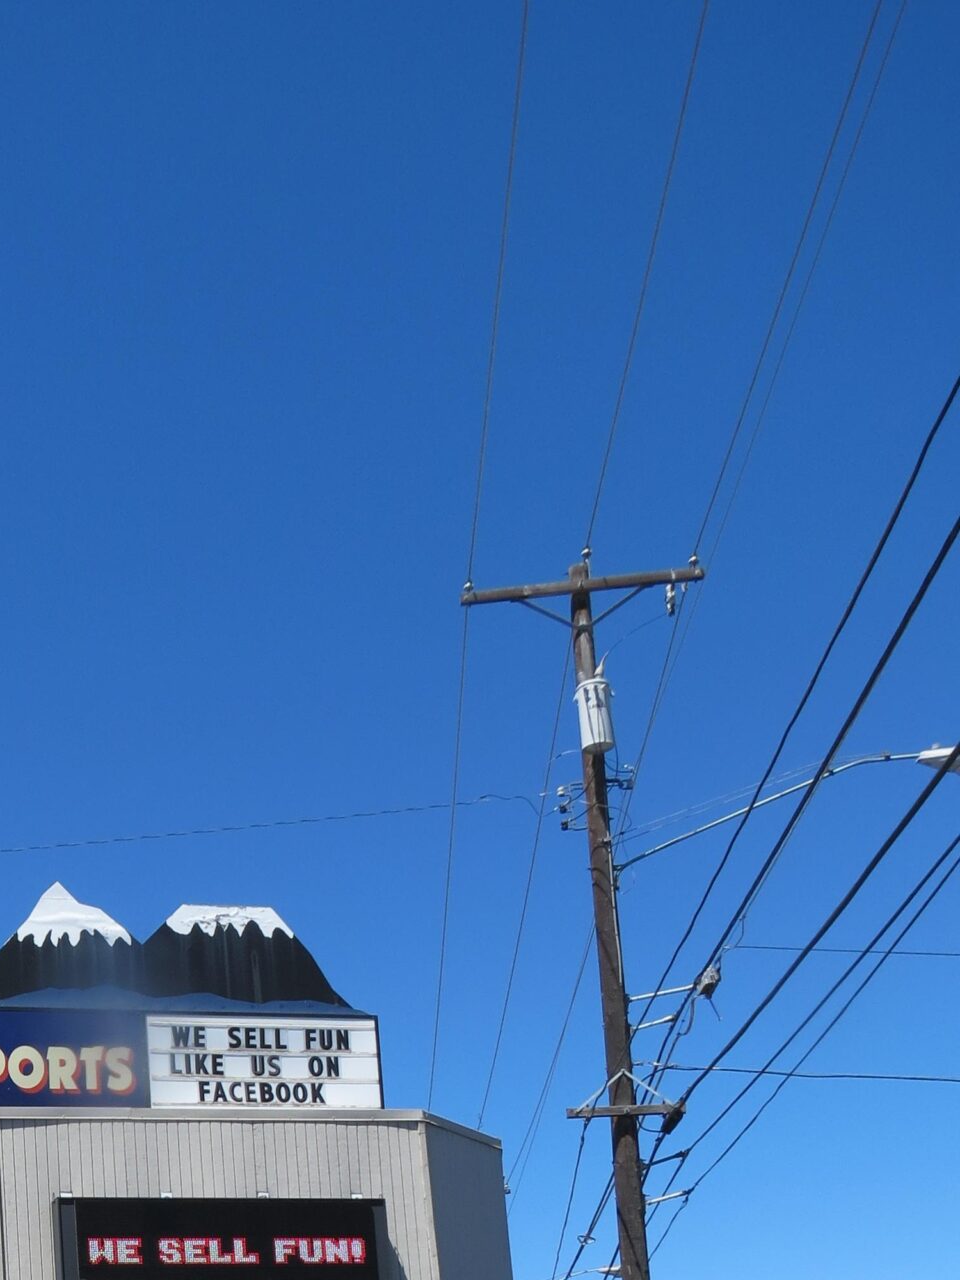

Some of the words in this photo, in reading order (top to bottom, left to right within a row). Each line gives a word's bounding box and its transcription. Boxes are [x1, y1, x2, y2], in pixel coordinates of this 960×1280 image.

[171, 1026, 206, 1049] WE
[228, 1026, 288, 1050] SELL
[305, 1028, 350, 1051] FUN
[170, 1053, 225, 1076] LIKE
[251, 1055, 281, 1077] US
[308, 1055, 339, 1077] ON
[198, 1081, 326, 1104] FACEBOOK
[87, 1237, 143, 1265] WE
[158, 1237, 259, 1265] SELL
[273, 1237, 366, 1265] FUN!
